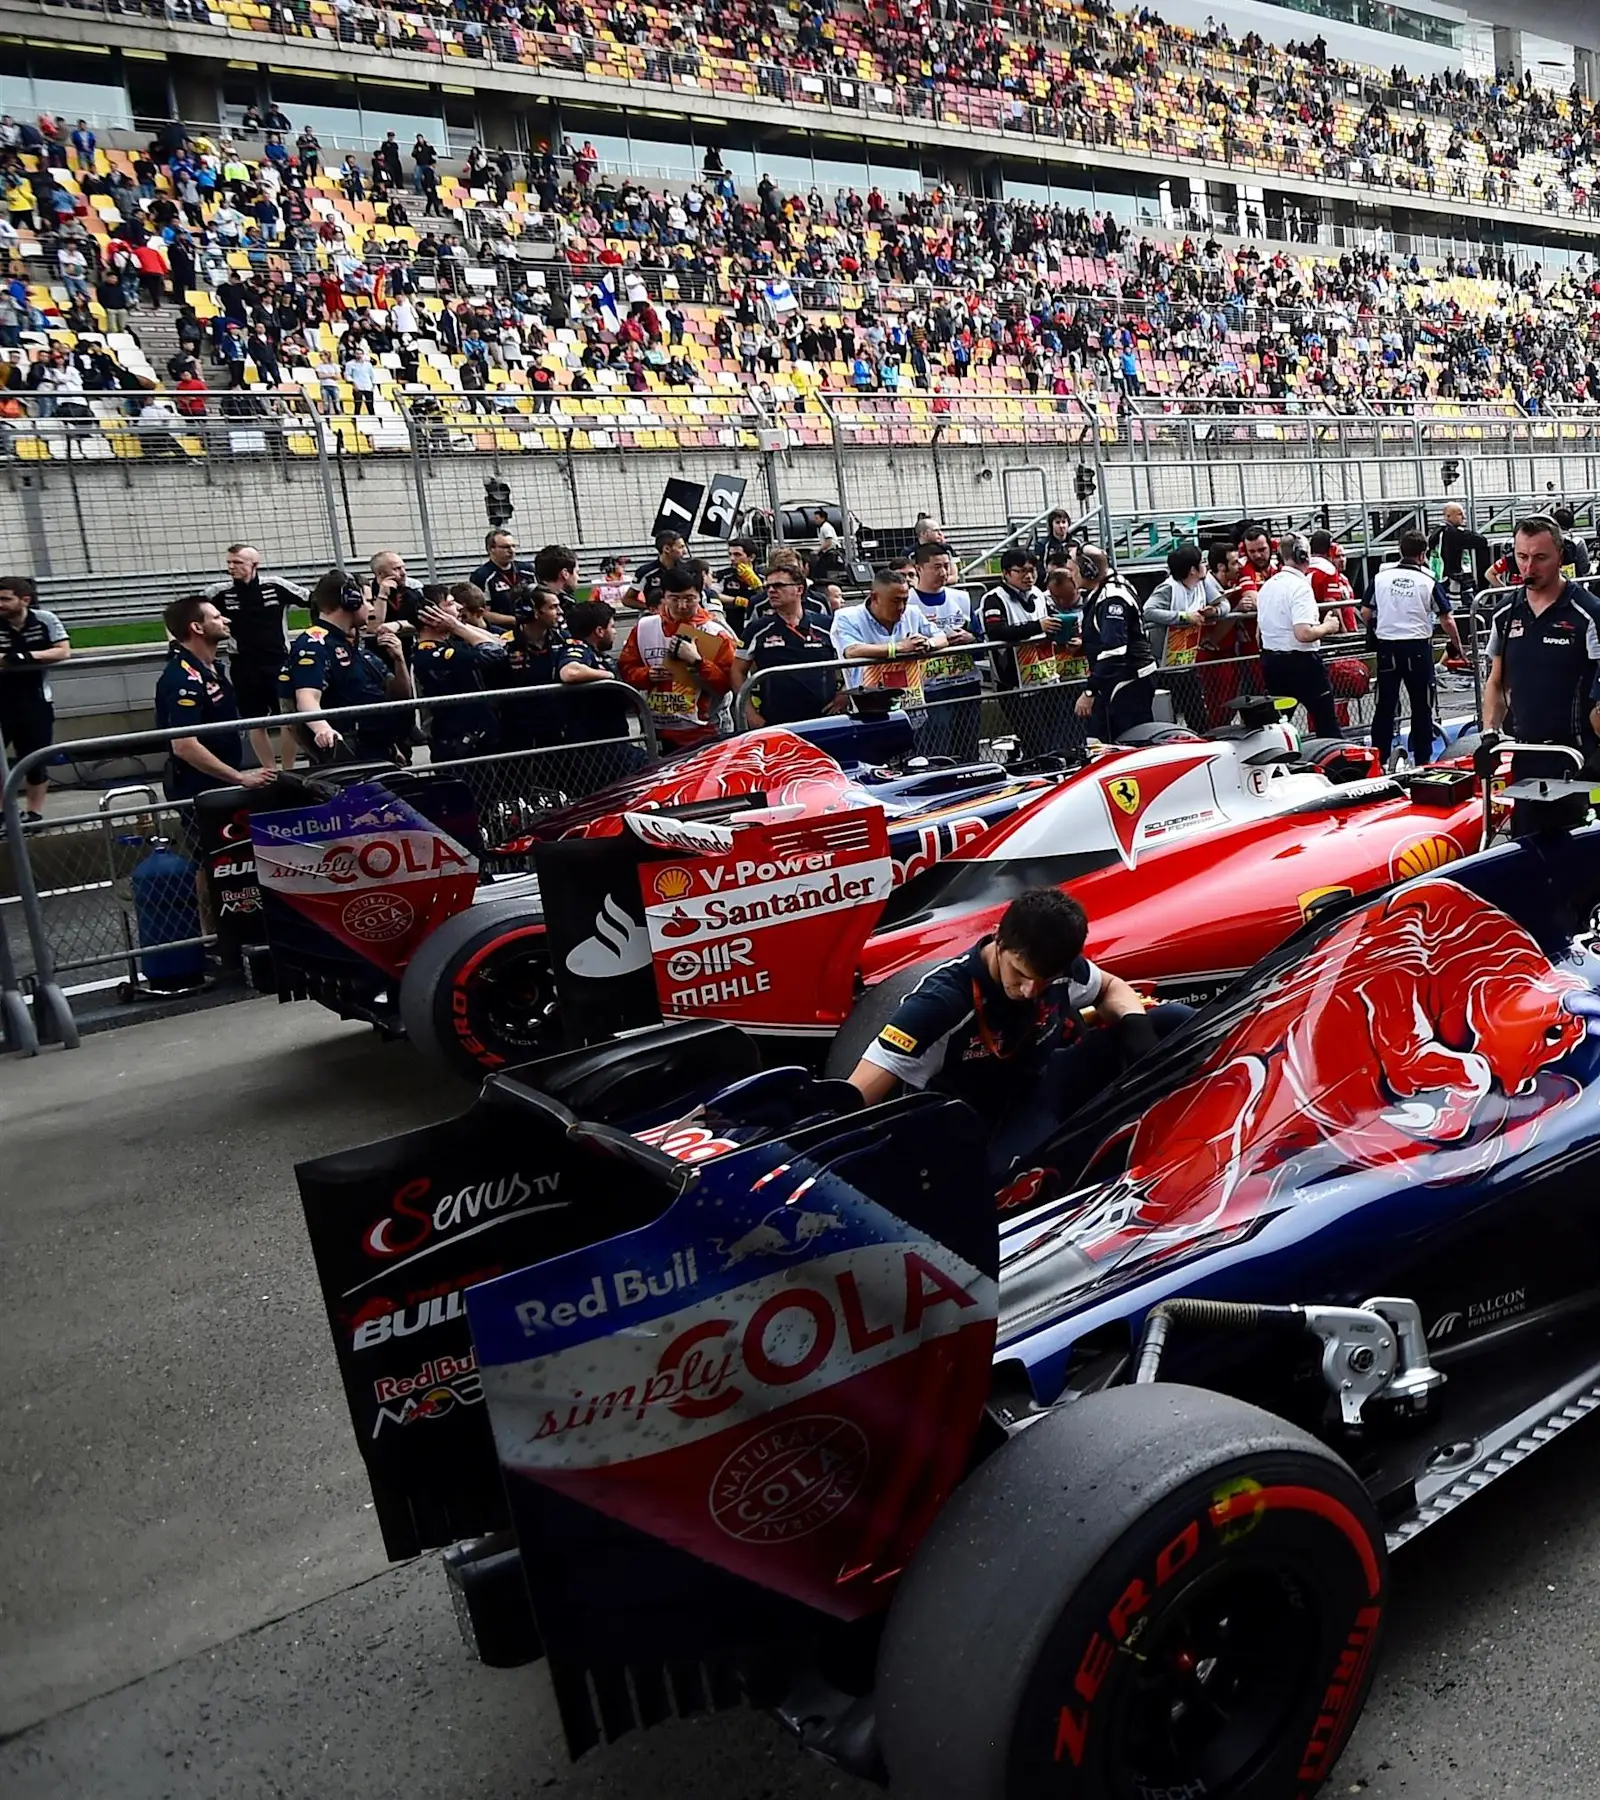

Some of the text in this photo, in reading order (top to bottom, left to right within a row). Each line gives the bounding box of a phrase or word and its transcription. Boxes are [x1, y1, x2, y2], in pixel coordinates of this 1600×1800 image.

[662, 498, 693, 522] 7
[707, 488, 739, 526] 22
[267, 816, 341, 839] Red Bull
[1144, 814, 1199, 831] SCUDERIA
[324, 837, 468, 884] COLA
[698, 853, 836, 892] V-Power
[354, 907, 402, 932] COLA
[705, 872, 876, 931] Santander
[671, 970, 772, 1013] MAHLE
[515, 1278, 607, 1337] Red
[614, 1247, 698, 1307] Bull
[1468, 1287, 1526, 1318] FALCON
[657, 1251, 978, 1419] COLA
[375, 1363, 433, 1404] Red
[527, 1350, 738, 1444] simply
[721, 1427, 818, 1502] NATURAL
[737, 1446, 846, 1524] COLA
[1055, 1520, 1199, 1768] ZERO
